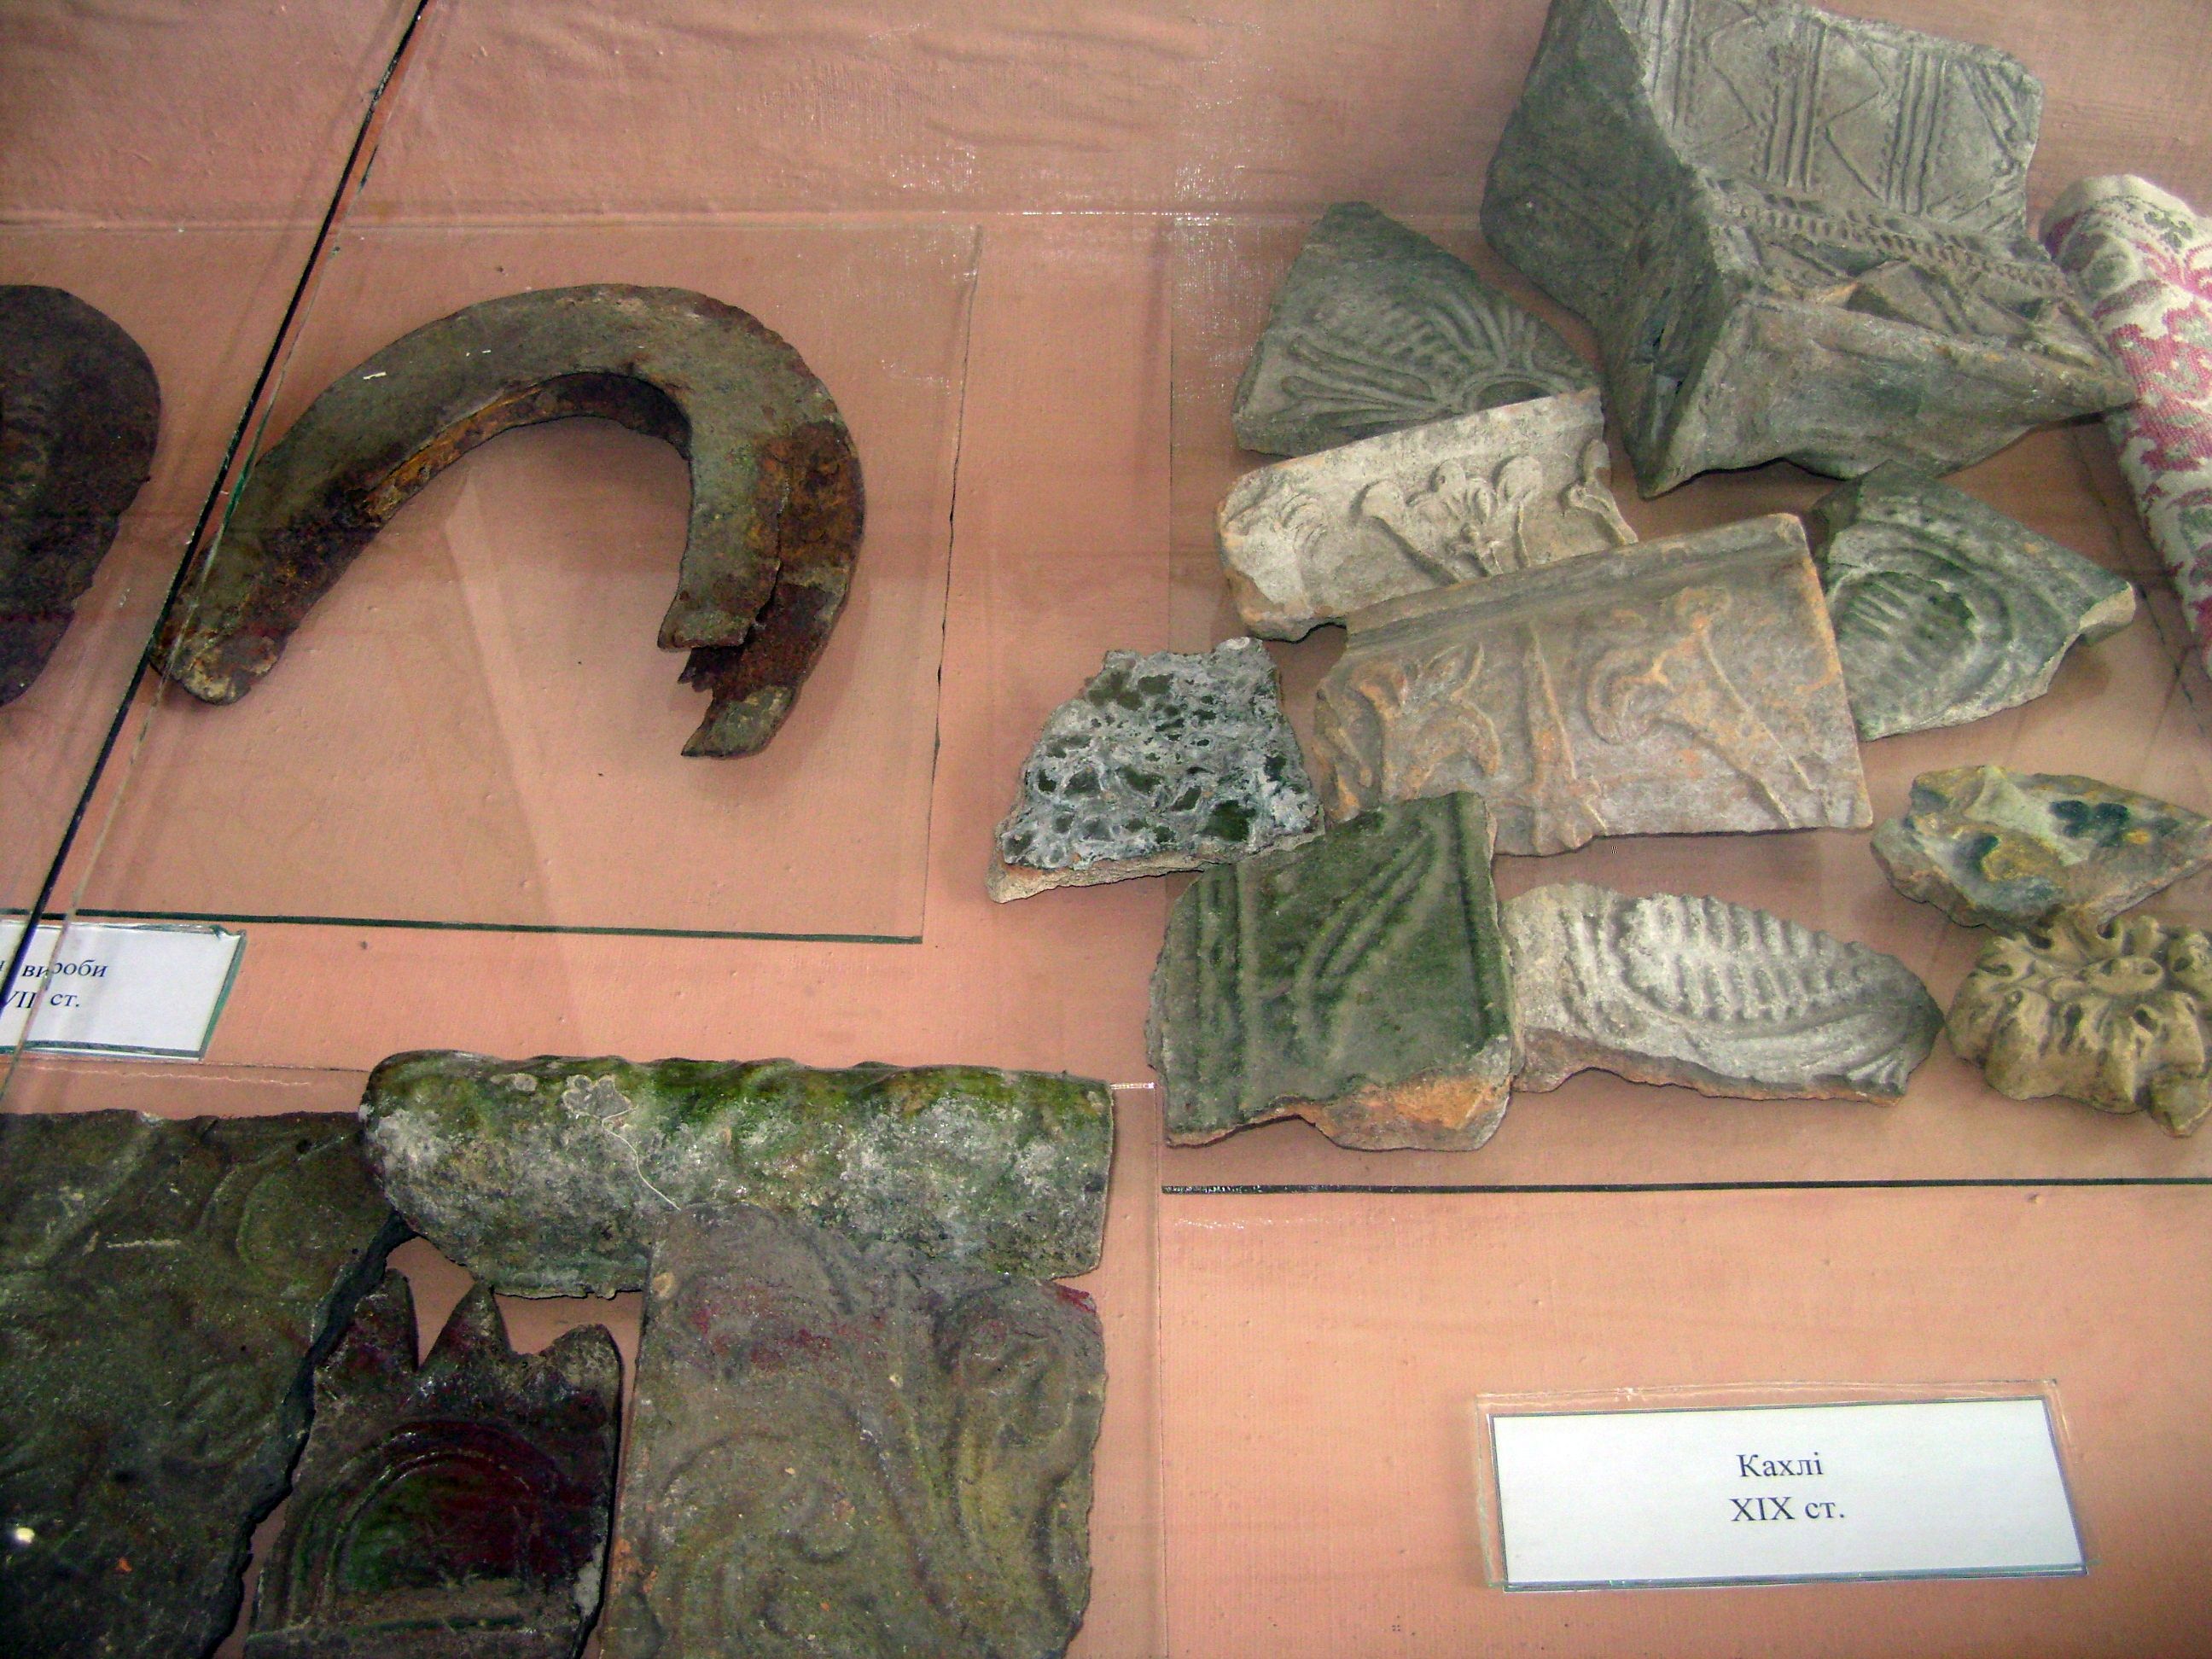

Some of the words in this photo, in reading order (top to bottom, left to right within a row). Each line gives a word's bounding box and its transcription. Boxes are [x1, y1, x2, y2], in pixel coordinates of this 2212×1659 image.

[50, 993, 80, 1008] ст.
[1736, 1452, 1824, 1477] Кахлі
[1729, 1496, 1796, 1522] XIX
[1804, 1501, 1845, 1519] ст.
